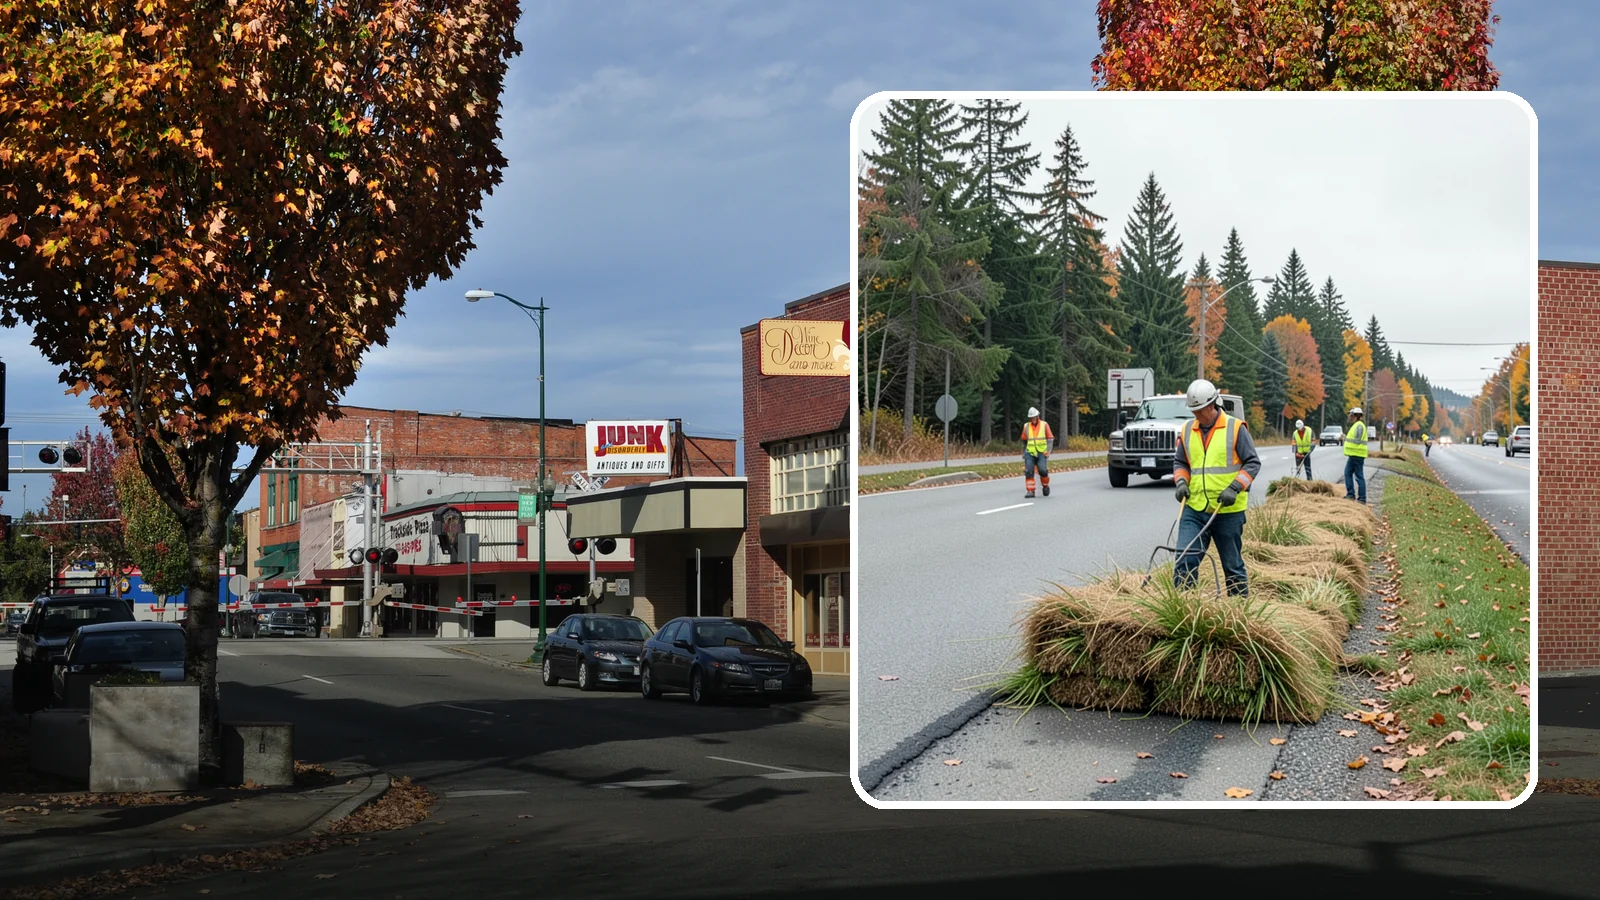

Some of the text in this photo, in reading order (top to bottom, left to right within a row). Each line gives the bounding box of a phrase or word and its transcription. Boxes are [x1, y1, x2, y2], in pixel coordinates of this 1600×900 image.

[595, 425, 665, 457] JUNK
[607, 446, 646, 454] DISORDERLY
[597, 460, 665, 470] ANTIQUES AND GIFTS
[390, 519, 429, 540] Trackside Pizza
